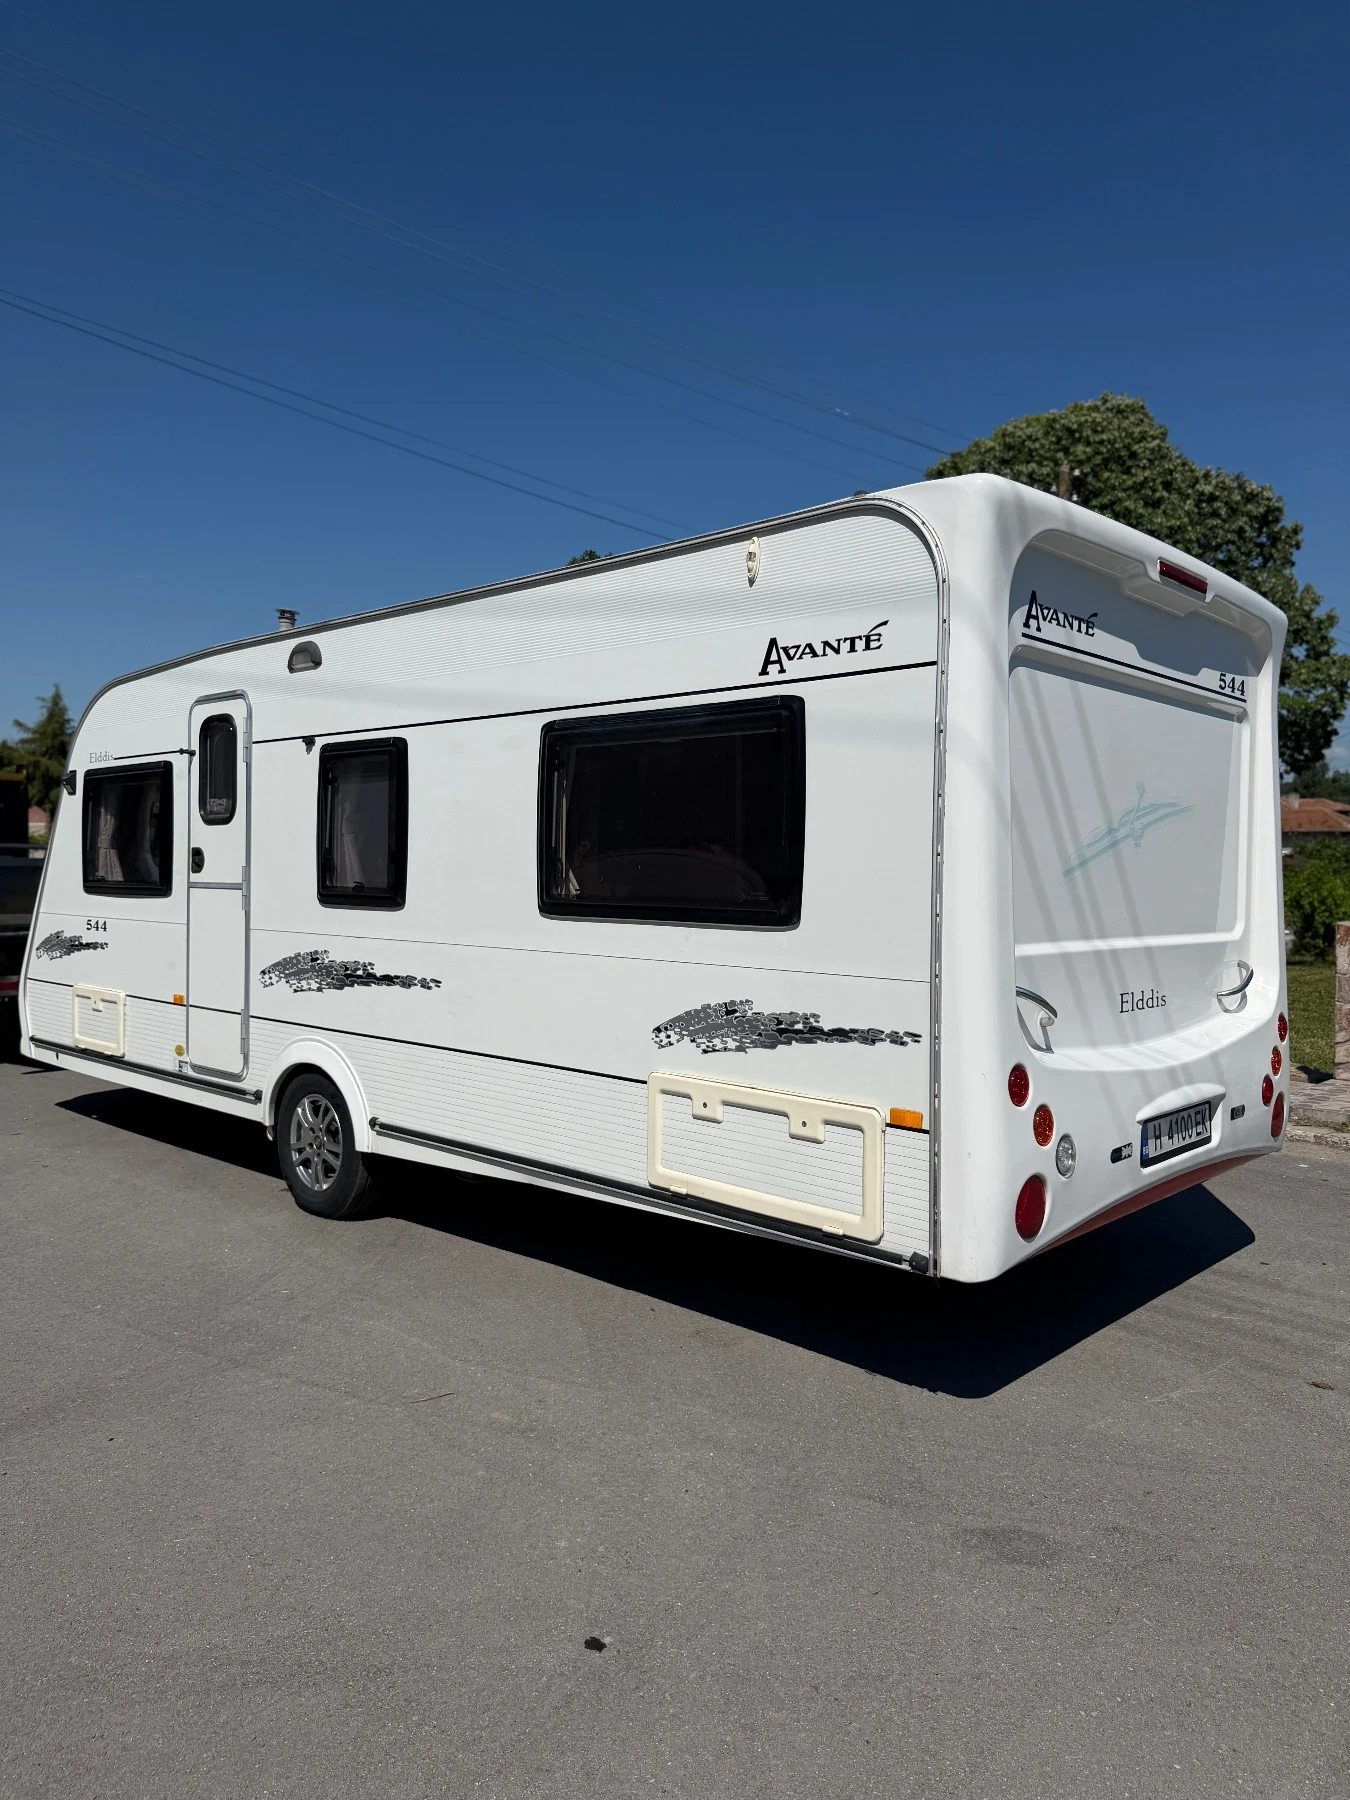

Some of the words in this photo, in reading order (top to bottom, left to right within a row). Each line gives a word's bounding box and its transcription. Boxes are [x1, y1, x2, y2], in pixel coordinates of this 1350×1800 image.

[1218, 672, 1246, 697] 544
[89, 750, 115, 764] Elddis
[86, 919, 108, 932] 544
[1119, 989, 1167, 1014] Elddis
